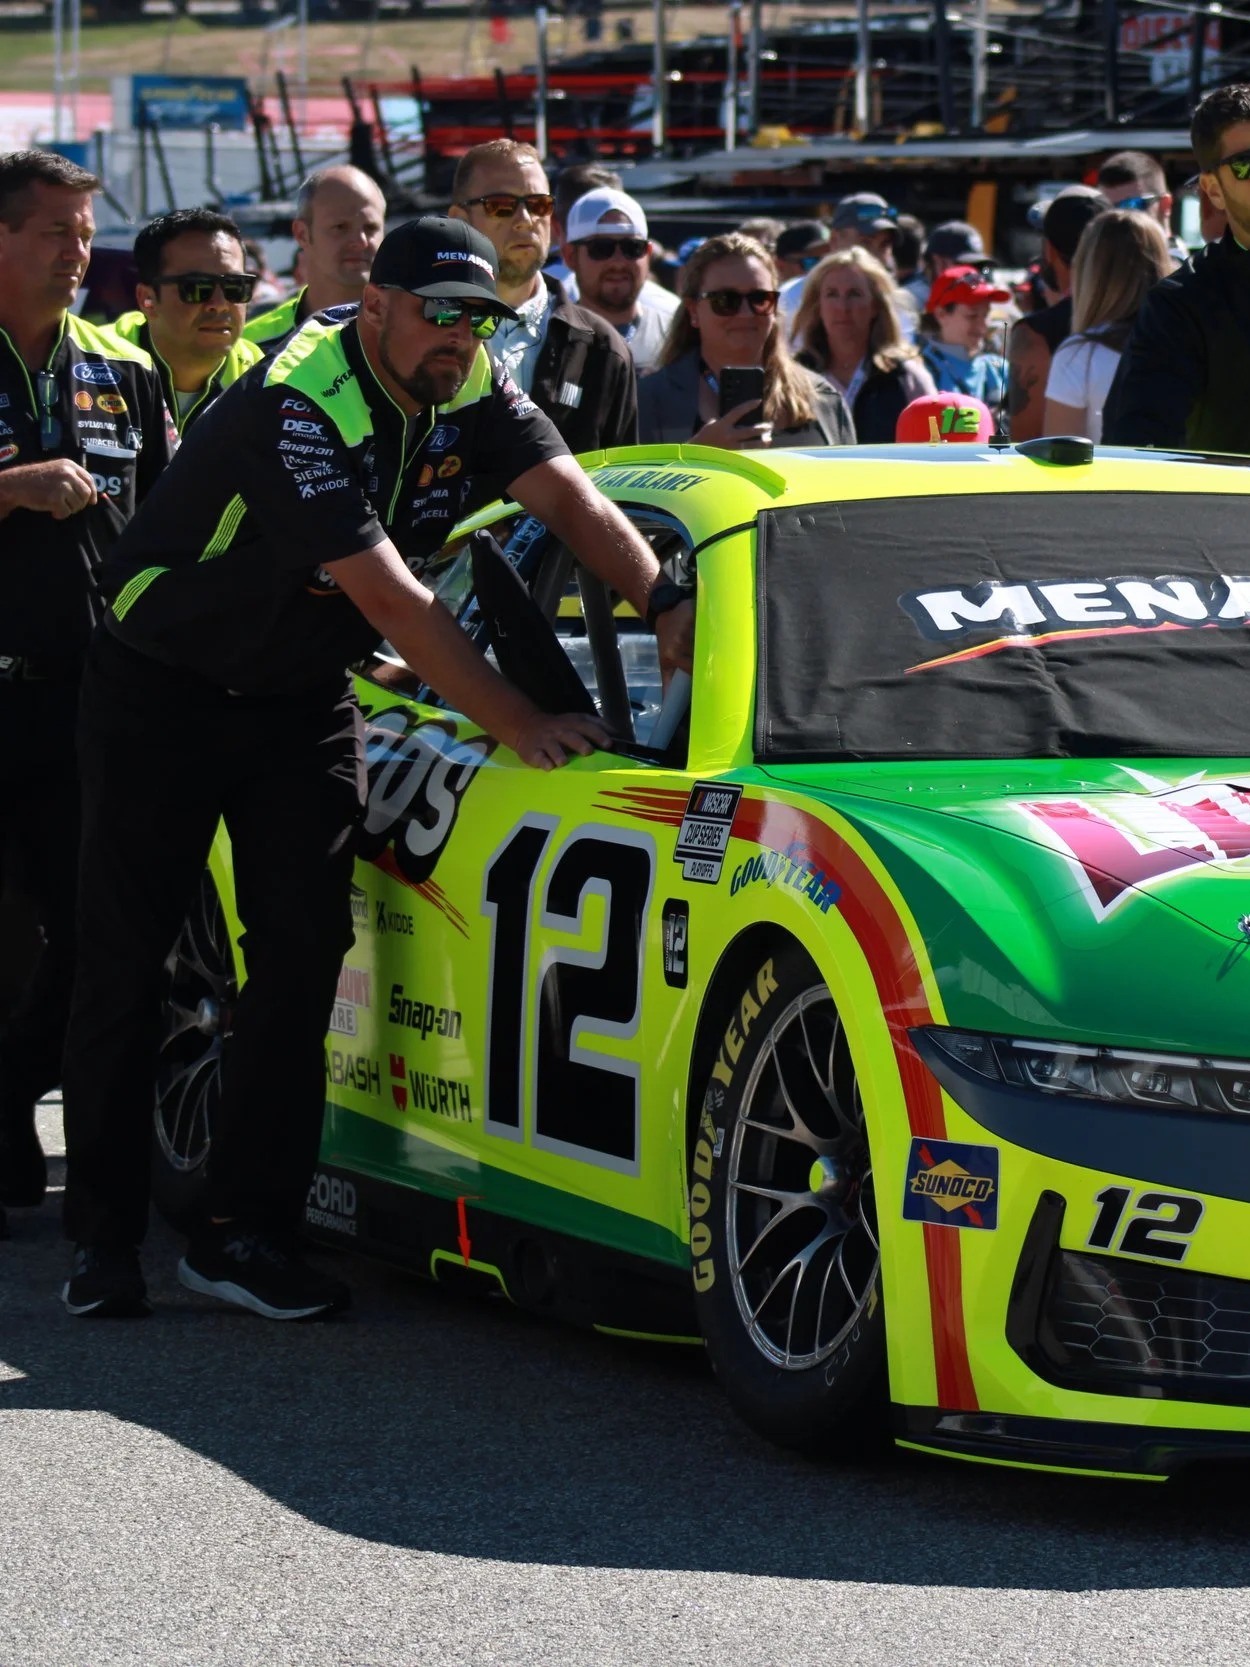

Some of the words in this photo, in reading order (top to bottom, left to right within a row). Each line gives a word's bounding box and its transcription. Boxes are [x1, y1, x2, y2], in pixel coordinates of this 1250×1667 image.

[283, 419, 324, 436] DEX
[940, 406, 981, 434] 12
[278, 440, 334, 456] Snap-on
[316, 478, 349, 492] KIDDE
[628, 470, 709, 492] BLANEY
[702, 790, 734, 815] NASCAR
[684, 822, 702, 845] CUP
[698, 824, 724, 848] SERIES
[689, 861, 715, 878] PLAYOFFS
[730, 850, 842, 915] GOODYEAR
[388, 913, 415, 936] KIDDE
[479, 810, 657, 1178] 12
[388, 983, 463, 1041] Snap-on
[408, 1068, 472, 1121] WÜRTH
[916, 1172, 991, 1201] SUNOCO
[1084, 1184, 1206, 1264] 12
